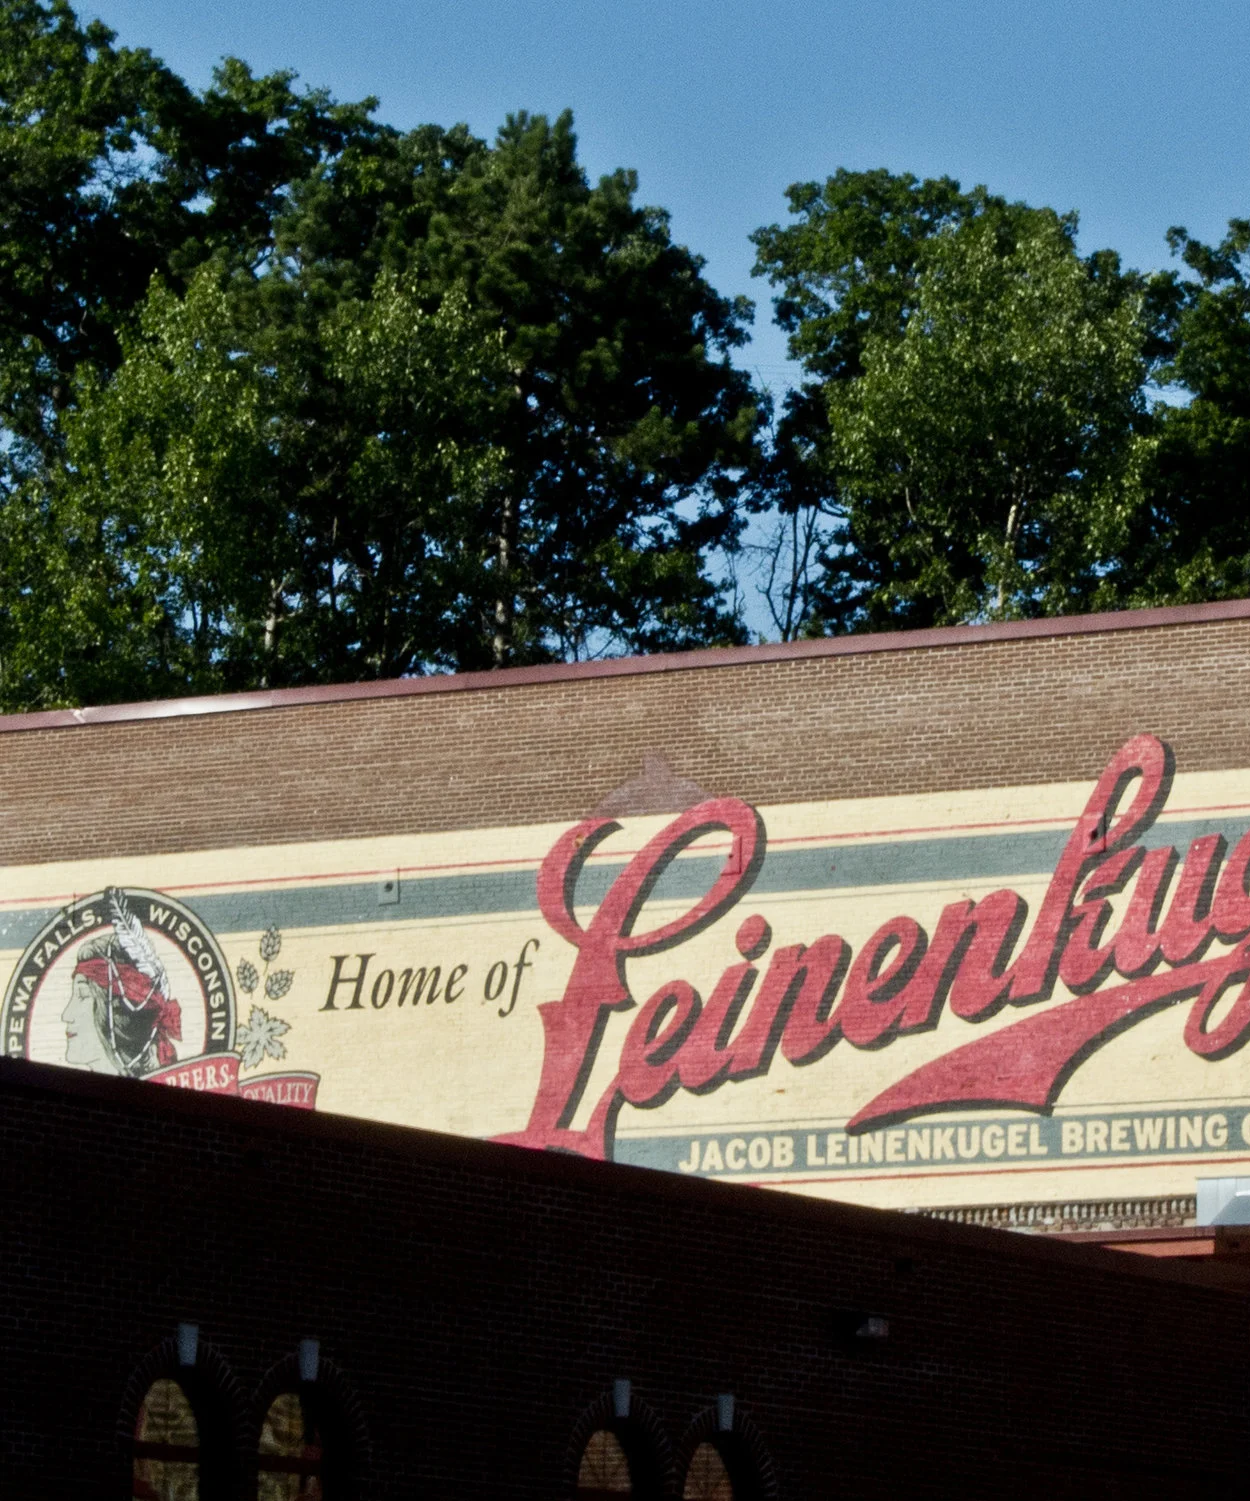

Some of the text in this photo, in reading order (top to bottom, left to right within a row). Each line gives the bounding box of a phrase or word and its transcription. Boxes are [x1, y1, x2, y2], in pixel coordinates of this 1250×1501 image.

[9, 904, 226, 1058] PEWA FALLS, WISCONSIN
[319, 938, 540, 1018] Home of
[679, 1135, 795, 1172] JACOB
[806, 1123, 1048, 1166] LEINENKUGEL
[1062, 1116, 1228, 1154] BREWING
